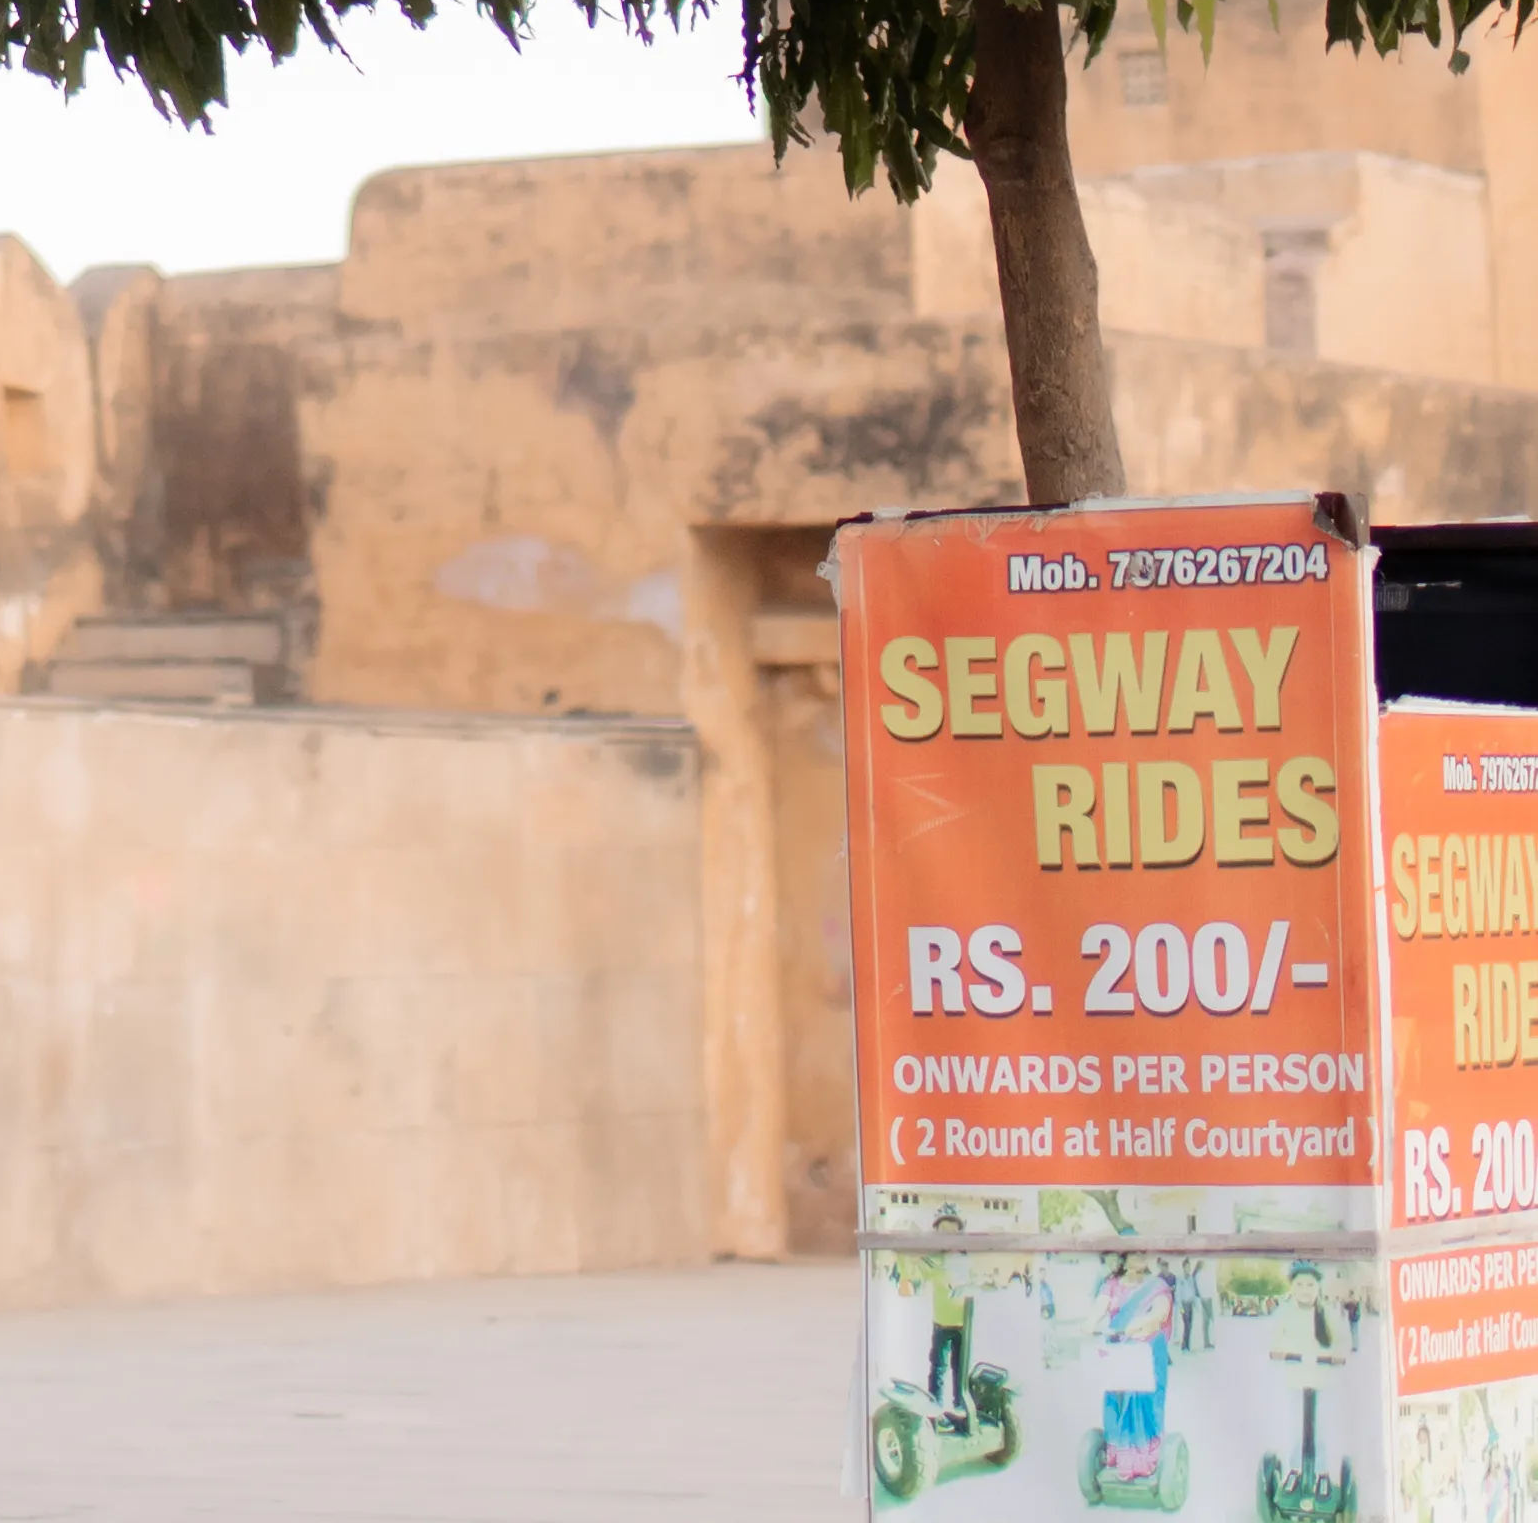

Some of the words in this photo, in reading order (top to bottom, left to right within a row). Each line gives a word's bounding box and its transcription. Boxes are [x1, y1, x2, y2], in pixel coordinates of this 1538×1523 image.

[1009, 554, 1099, 592] Mob.
[880, 626, 1299, 740] SEGWAY
[1443, 755, 1478, 793] Mob.
[1031, 756, 1340, 871] RIDES
[907, 924, 1054, 1017] RS.
[1080, 920, 1329, 1017] 200/-
[893, 1055, 1102, 1095] ONWARDS
[1113, 1055, 1190, 1094] PER
[1201, 1053, 1365, 1093] PERSON
[946, 1117, 1053, 1158] Round
[1063, 1120, 1101, 1158] at
[1110, 1118, 1176, 1158] Half
[1184, 1117, 1355, 1167] Courtyard
[1404, 1126, 1462, 1223] RS.
[1399, 1255, 1481, 1302] ONWARDS
[1484, 1250, 1513, 1290] PER
[1420, 1319, 1464, 1364] Round
[1466, 1319, 1482, 1356] at
[1483, 1311, 1510, 1353] Half
